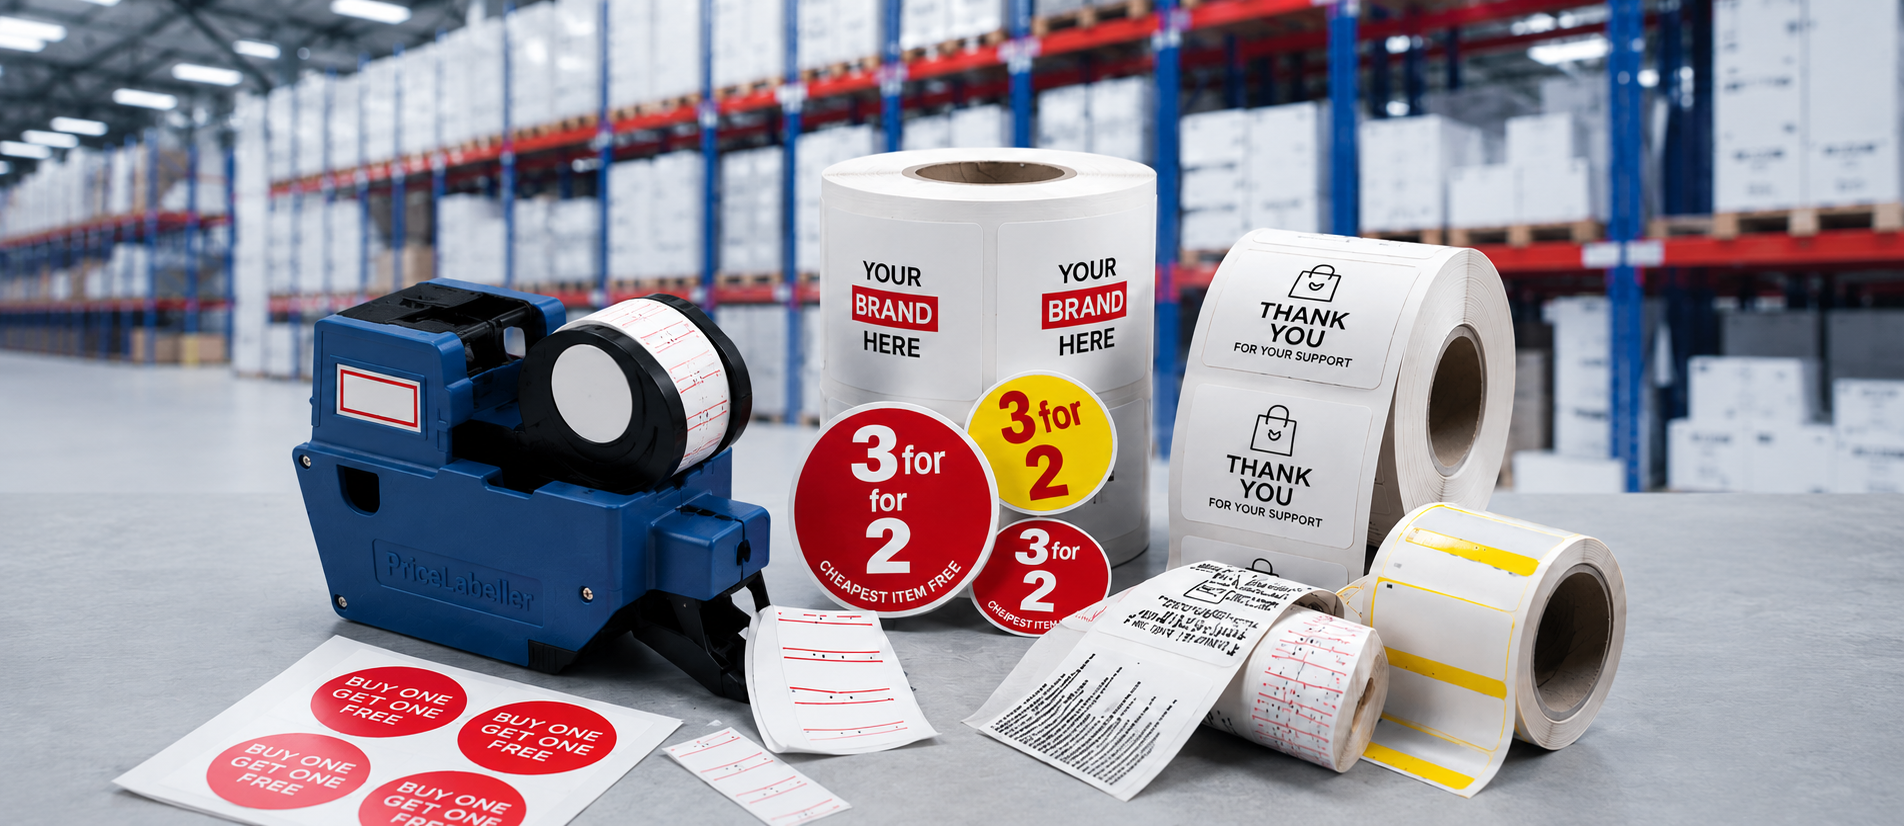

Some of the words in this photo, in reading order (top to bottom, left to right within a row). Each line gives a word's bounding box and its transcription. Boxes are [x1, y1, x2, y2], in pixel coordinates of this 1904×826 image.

[863, 261, 921, 287] YOUR
[1059, 258, 1116, 283] YOUR
[857, 294, 932, 324] BRAND
[1049, 291, 1123, 322] BRAND
[1261, 302, 1350, 330] THANK
[864, 330, 920, 358] HERE
[1060, 327, 1115, 356] HERE
[1271, 323, 1325, 347] YOU
[1234, 342, 1257, 354] FOR
[1261, 346, 1292, 359] YOUR
[1295, 351, 1352, 367] SUPPORT
[999, 391, 1036, 444] 3
[1039, 401, 1080, 433] for
[851, 425, 897, 482] 3
[902, 445, 945, 474] for
[1026, 445, 1069, 501] 2
[1227, 454, 1312, 487] THANK
[870, 489, 907, 512] for
[1240, 479, 1293, 506] YOU
[1209, 497, 1231, 510] FOR
[1235, 502, 1265, 516] YOUR
[1269, 509, 1322, 527] SUPPORT
[866, 518, 910, 574] 2
[1015, 528, 1049, 565] 3
[1052, 542, 1080, 559] for
[386, 552, 534, 611] PriceLabeller
[820, 561, 888, 603] CHEAPEST
[893, 586, 927, 603] ITEM
[928, 561, 961, 592] FREE
[1020, 570, 1056, 612] 2
[332, 688, 387, 706] GET
[389, 700, 444, 719] ONE
[344, 676, 399, 693] BUY
[399, 688, 453, 706] ONE
[339, 704, 404, 725] FREE
[492, 712, 546, 729] BUY
[548, 724, 603, 742] ONE
[481, 724, 535, 741] GET
[538, 736, 594, 756] ONE
[487, 739, 554, 762] FREE
[230, 756, 287, 774] GET
[289, 769, 346, 789] ONE
[244, 743, 300, 761] BUY
[300, 755, 357, 775] ONE
[236, 772, 304, 796] FREE
[396, 781, 454, 801] BUY
[454, 794, 512, 815] ONE
[383, 795, 442, 815] GET
[443, 808, 502, 826] ONE
[390, 812, 455, 826] FRE
